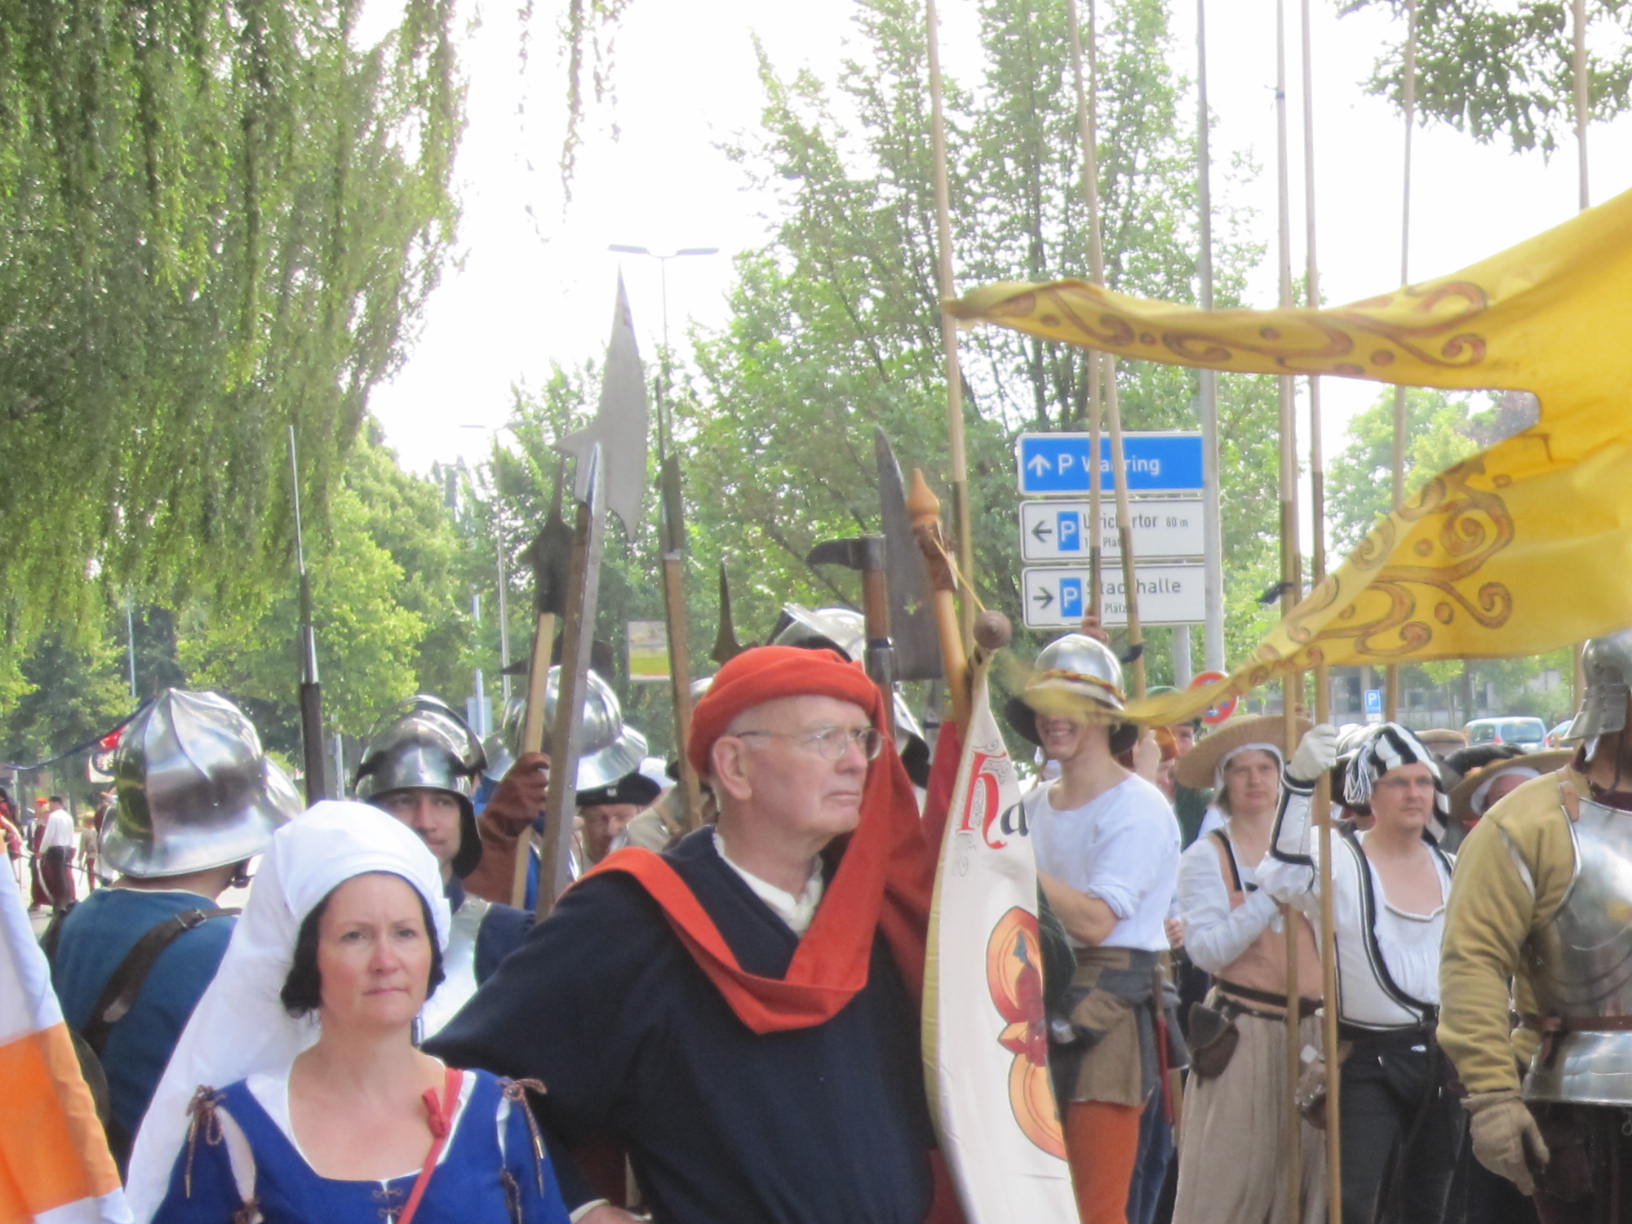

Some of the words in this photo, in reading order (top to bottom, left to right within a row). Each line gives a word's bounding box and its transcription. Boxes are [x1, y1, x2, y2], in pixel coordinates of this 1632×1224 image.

[1058, 453, 1073, 476] P
[1081, 455, 1161, 476] Waring
[1060, 520, 1076, 542] P
[1063, 586, 1079, 608] P
[1086, 577, 1181, 595] tadhalle
